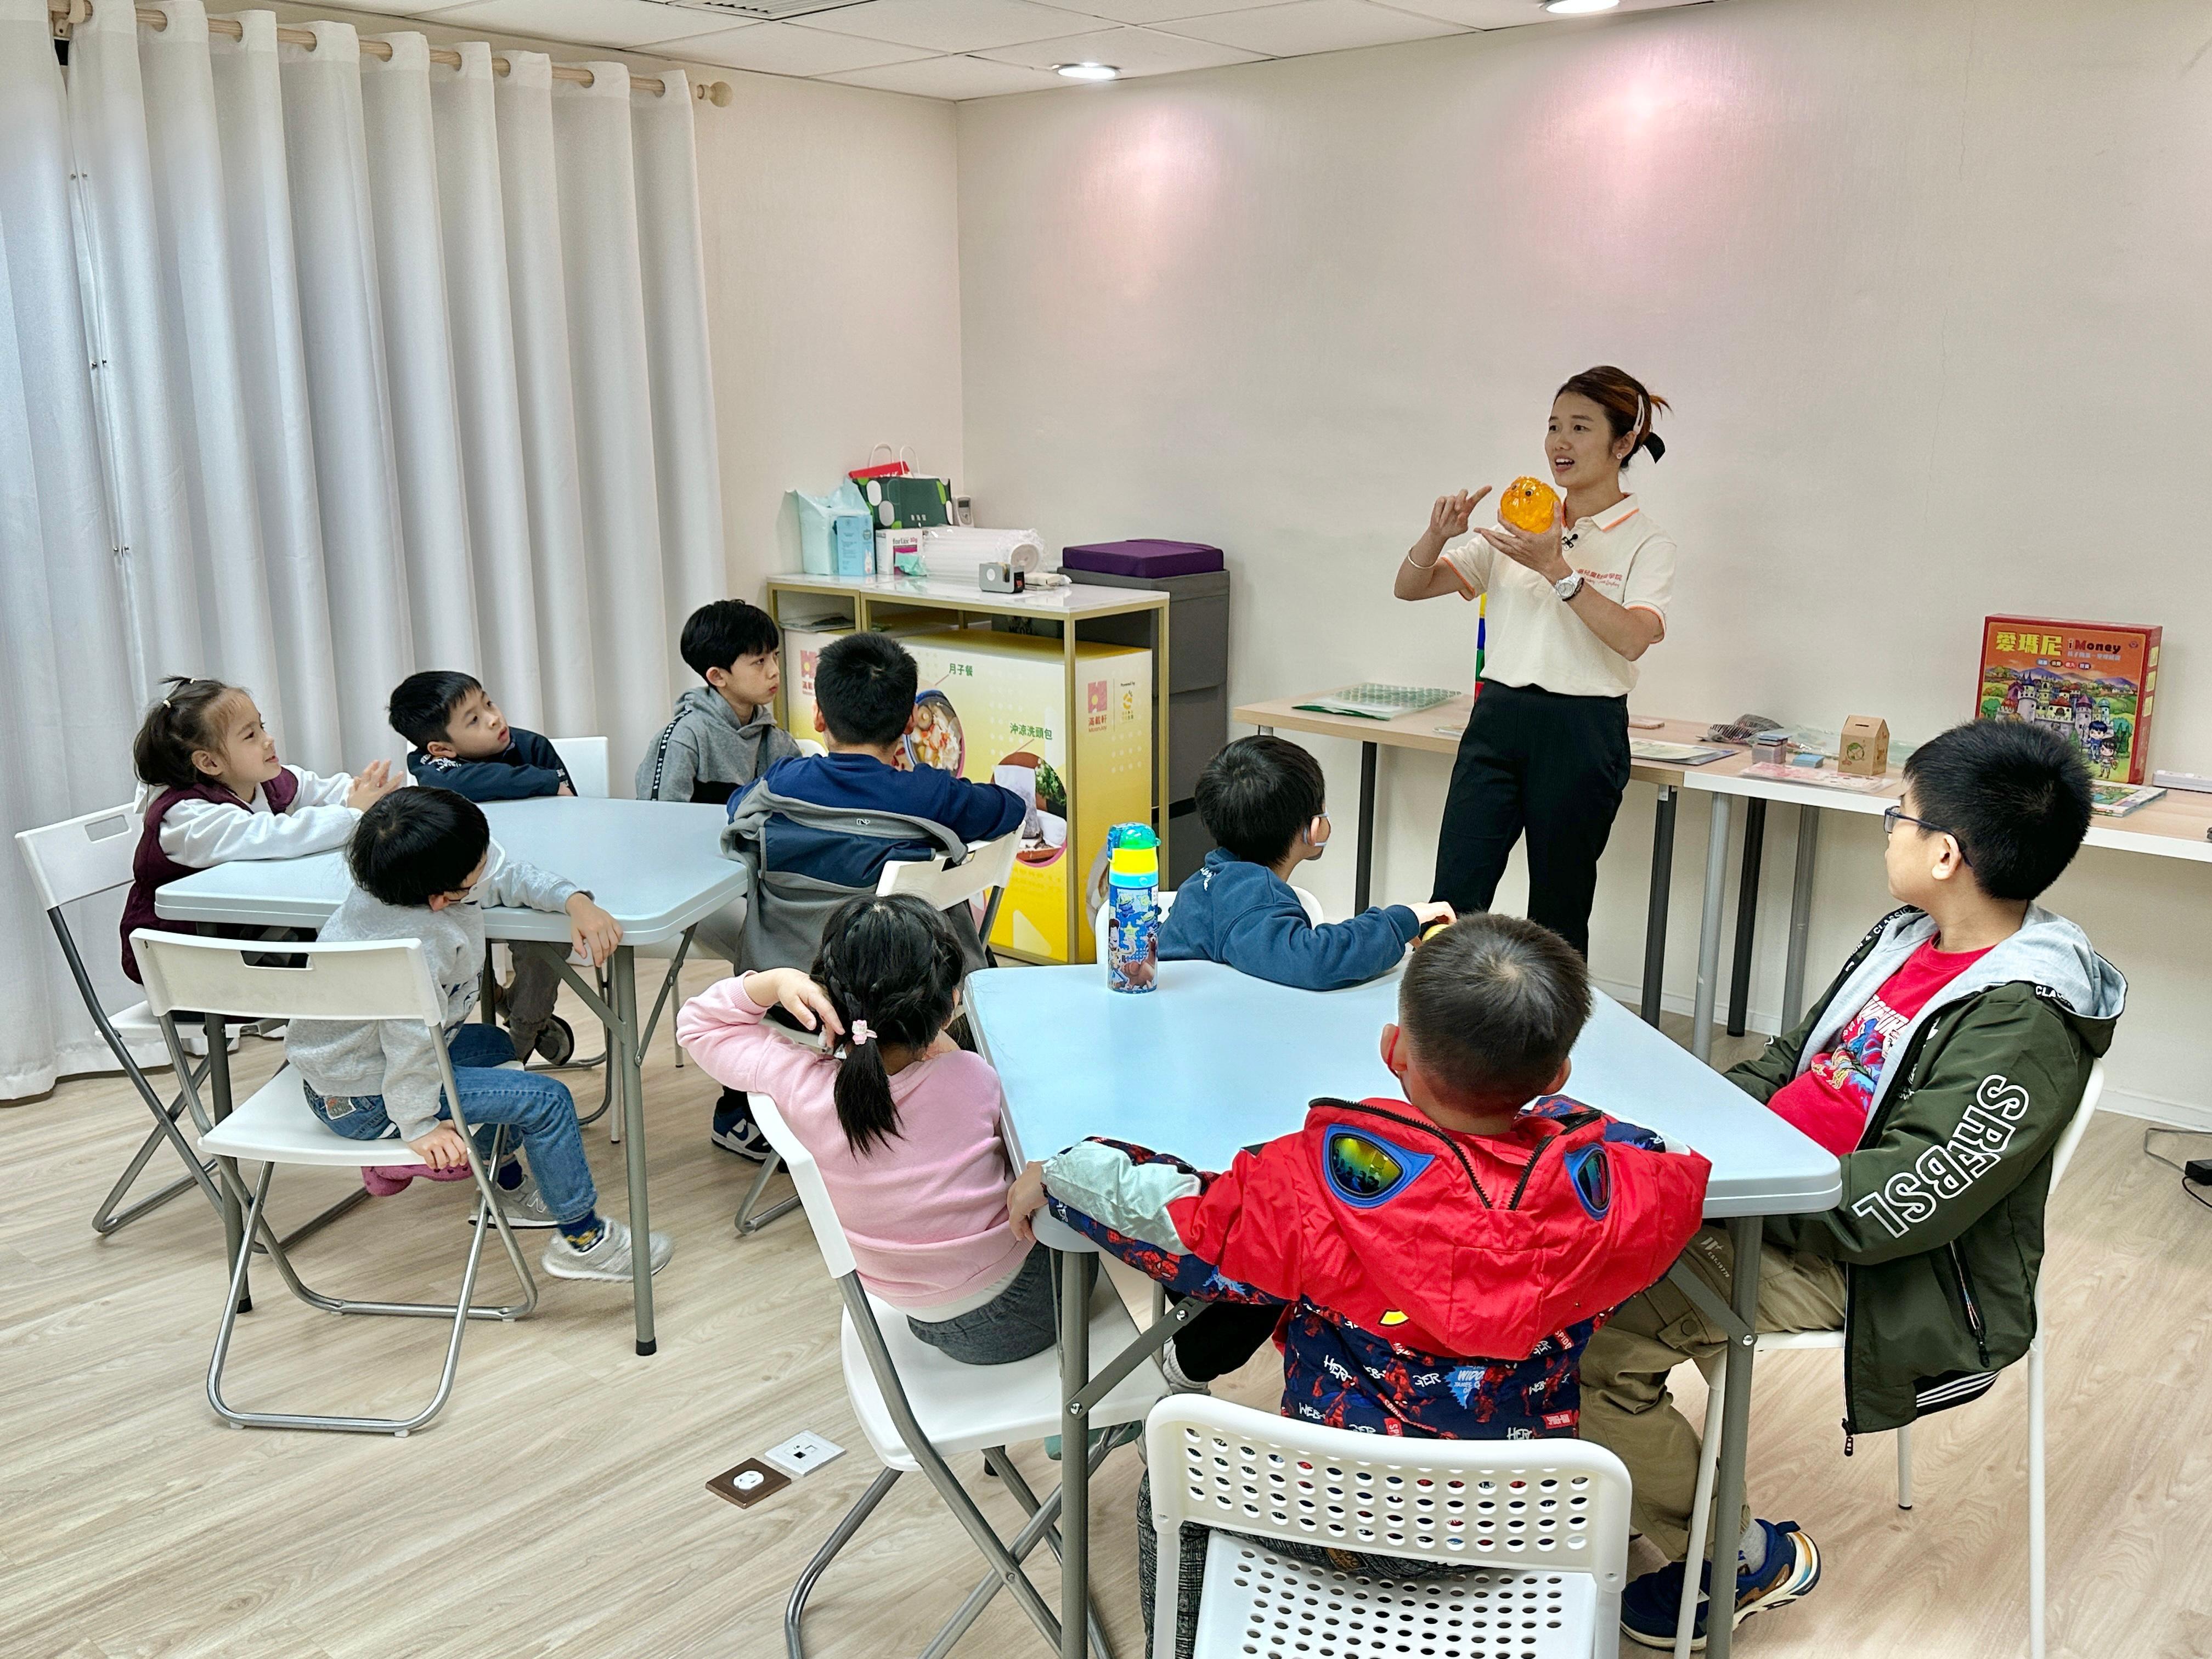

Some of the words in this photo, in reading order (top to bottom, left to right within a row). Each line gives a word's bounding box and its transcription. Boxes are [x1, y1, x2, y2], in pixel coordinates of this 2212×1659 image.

[949, 663, 973, 677] 月子餐
[1009, 722, 1053, 740] 沖涼洗頭包
